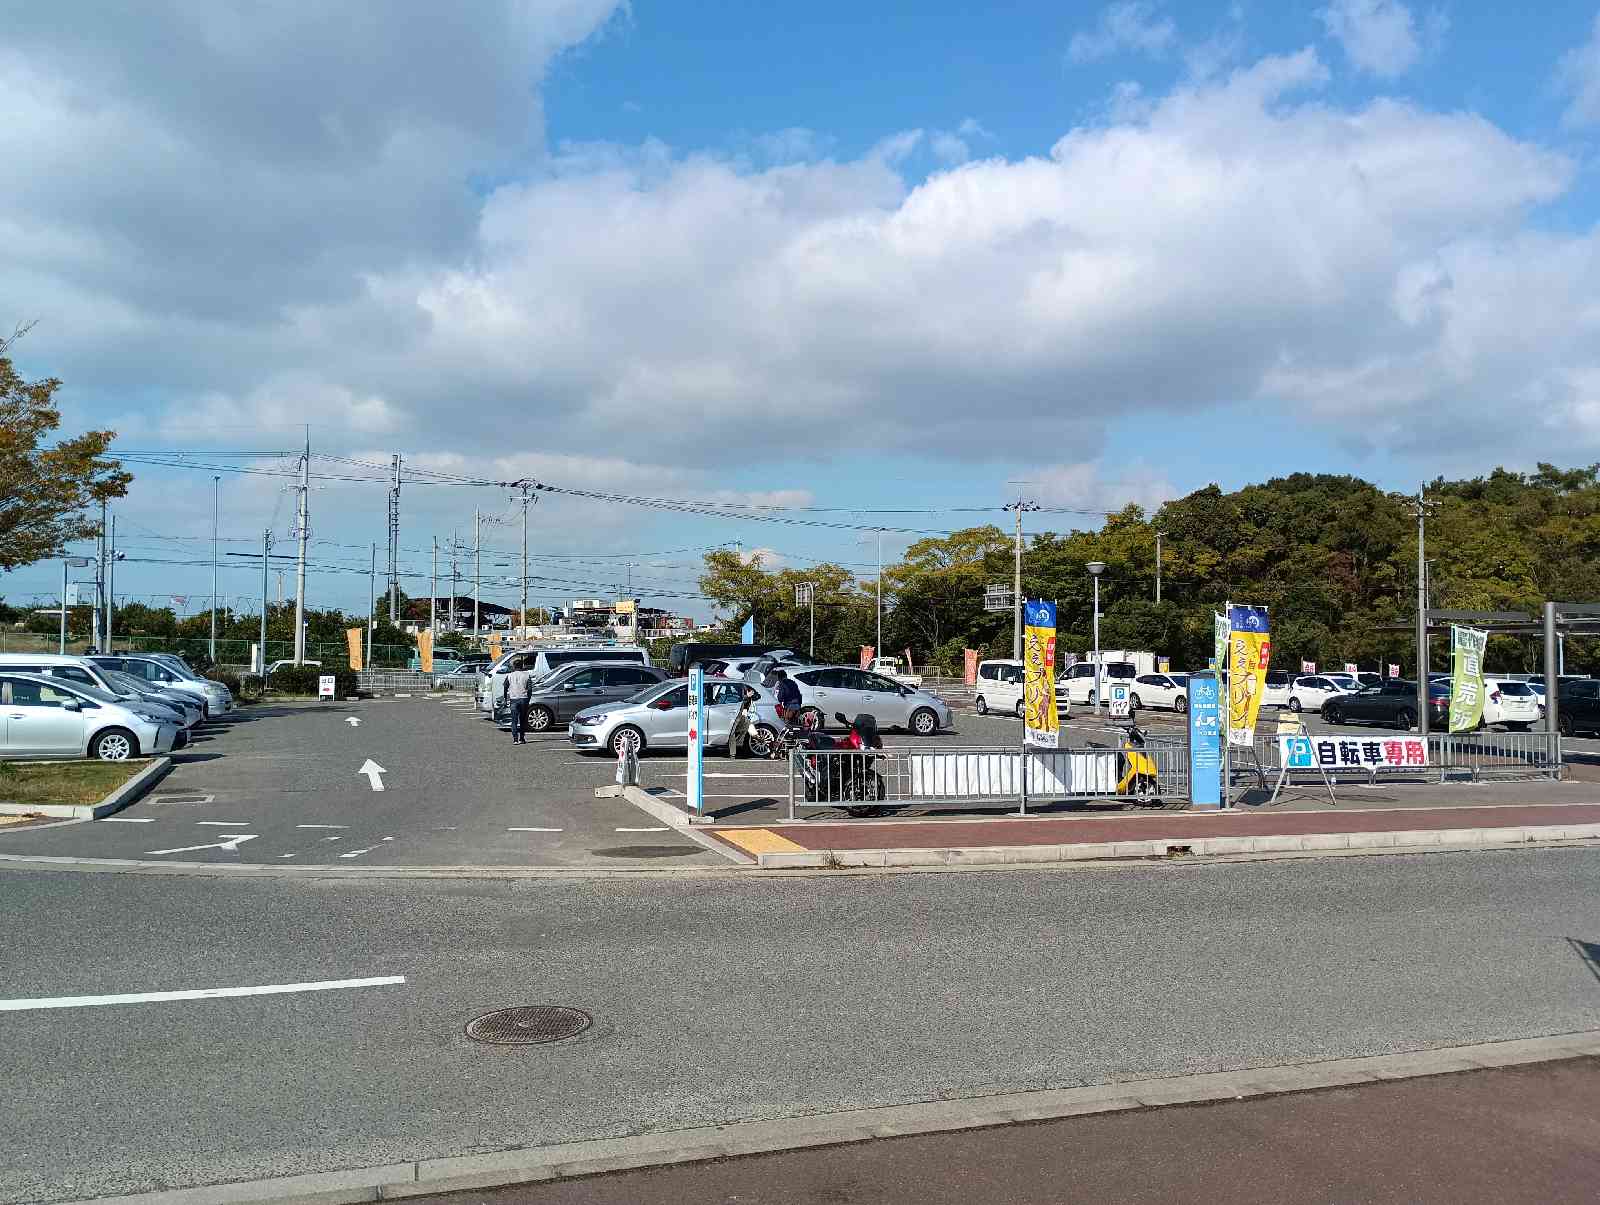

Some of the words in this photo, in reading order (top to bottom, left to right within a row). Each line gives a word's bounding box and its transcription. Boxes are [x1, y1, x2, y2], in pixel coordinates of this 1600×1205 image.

[1454, 655, 1479, 730] 直売所
[1317, 740, 1425, 766] 自転車専用
